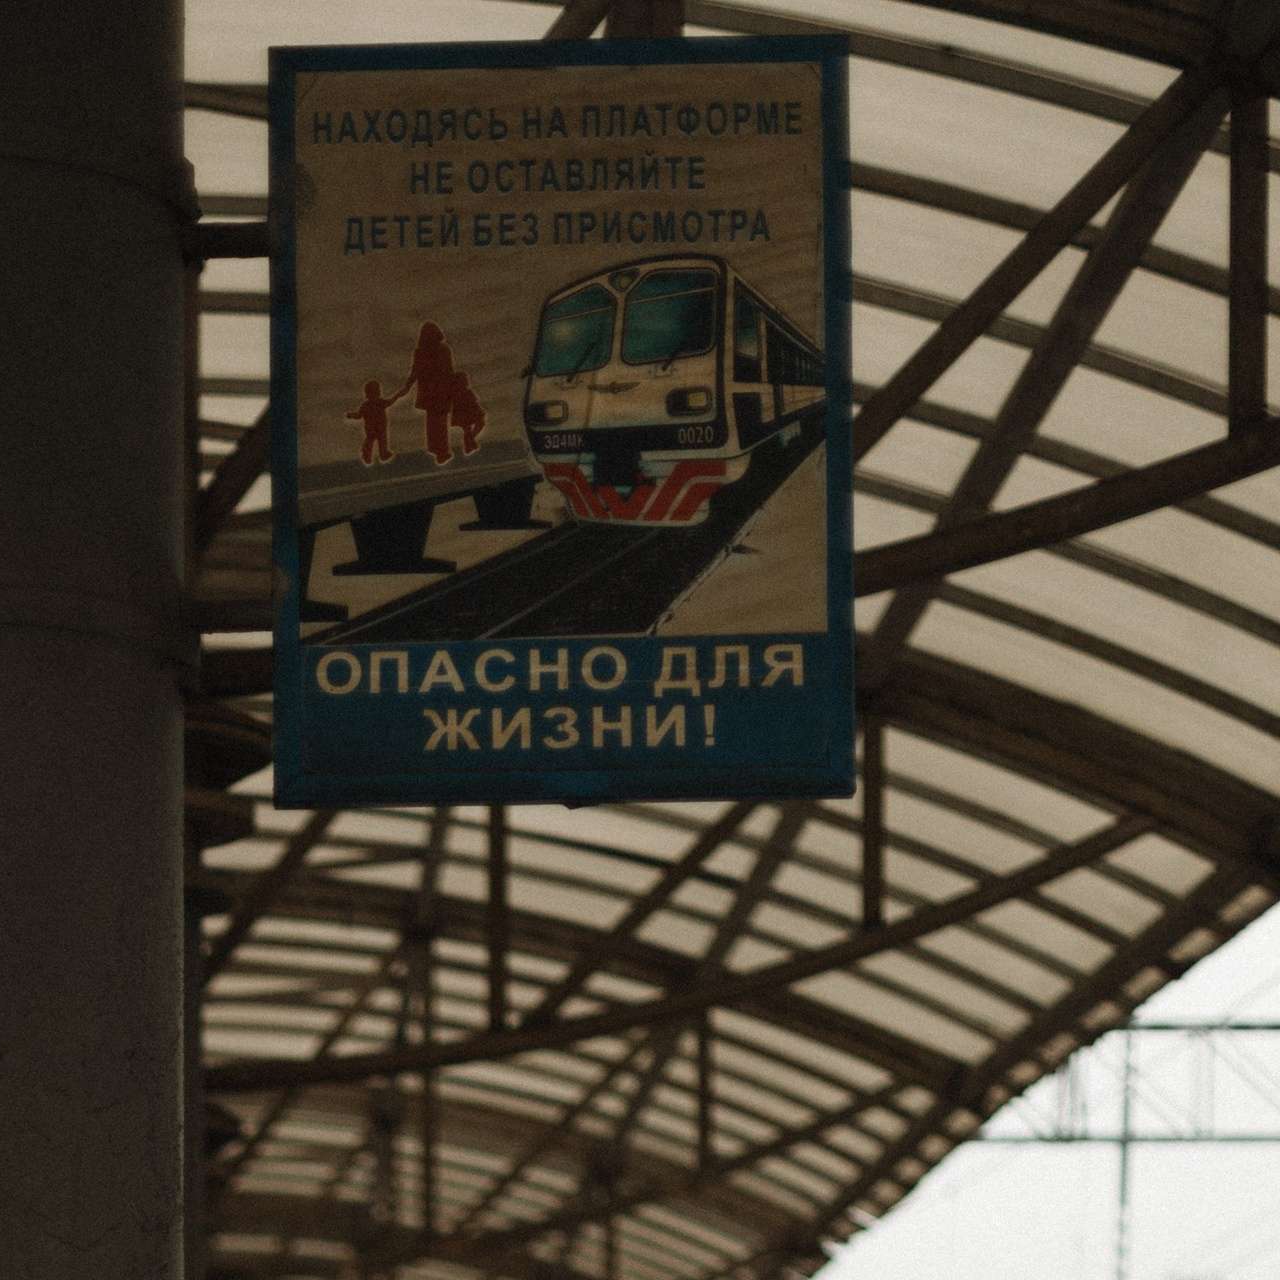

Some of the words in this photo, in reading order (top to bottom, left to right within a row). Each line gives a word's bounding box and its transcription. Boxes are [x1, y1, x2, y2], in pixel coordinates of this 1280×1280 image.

[312, 108, 509, 148] НАХОДЯСЬ
[523, 106, 569, 139] НА
[581, 100, 803, 139] ПЛАТФОРМЕ
[410, 160, 454, 195] НЕ
[468, 149, 707, 193] ОСТАВЛЯЙТЕ
[343, 207, 460, 256] ДЕТЕЙ
[473, 213, 540, 247] БЕЗ
[553, 208, 771, 245] ПРИСМОТРА
[678, 426, 714, 444] 0020
[316, 644, 627, 694] ОПАСНО
[654, 643, 804, 697] ДЛЯ
[423, 704, 717, 750] ЖИЗНИ!
